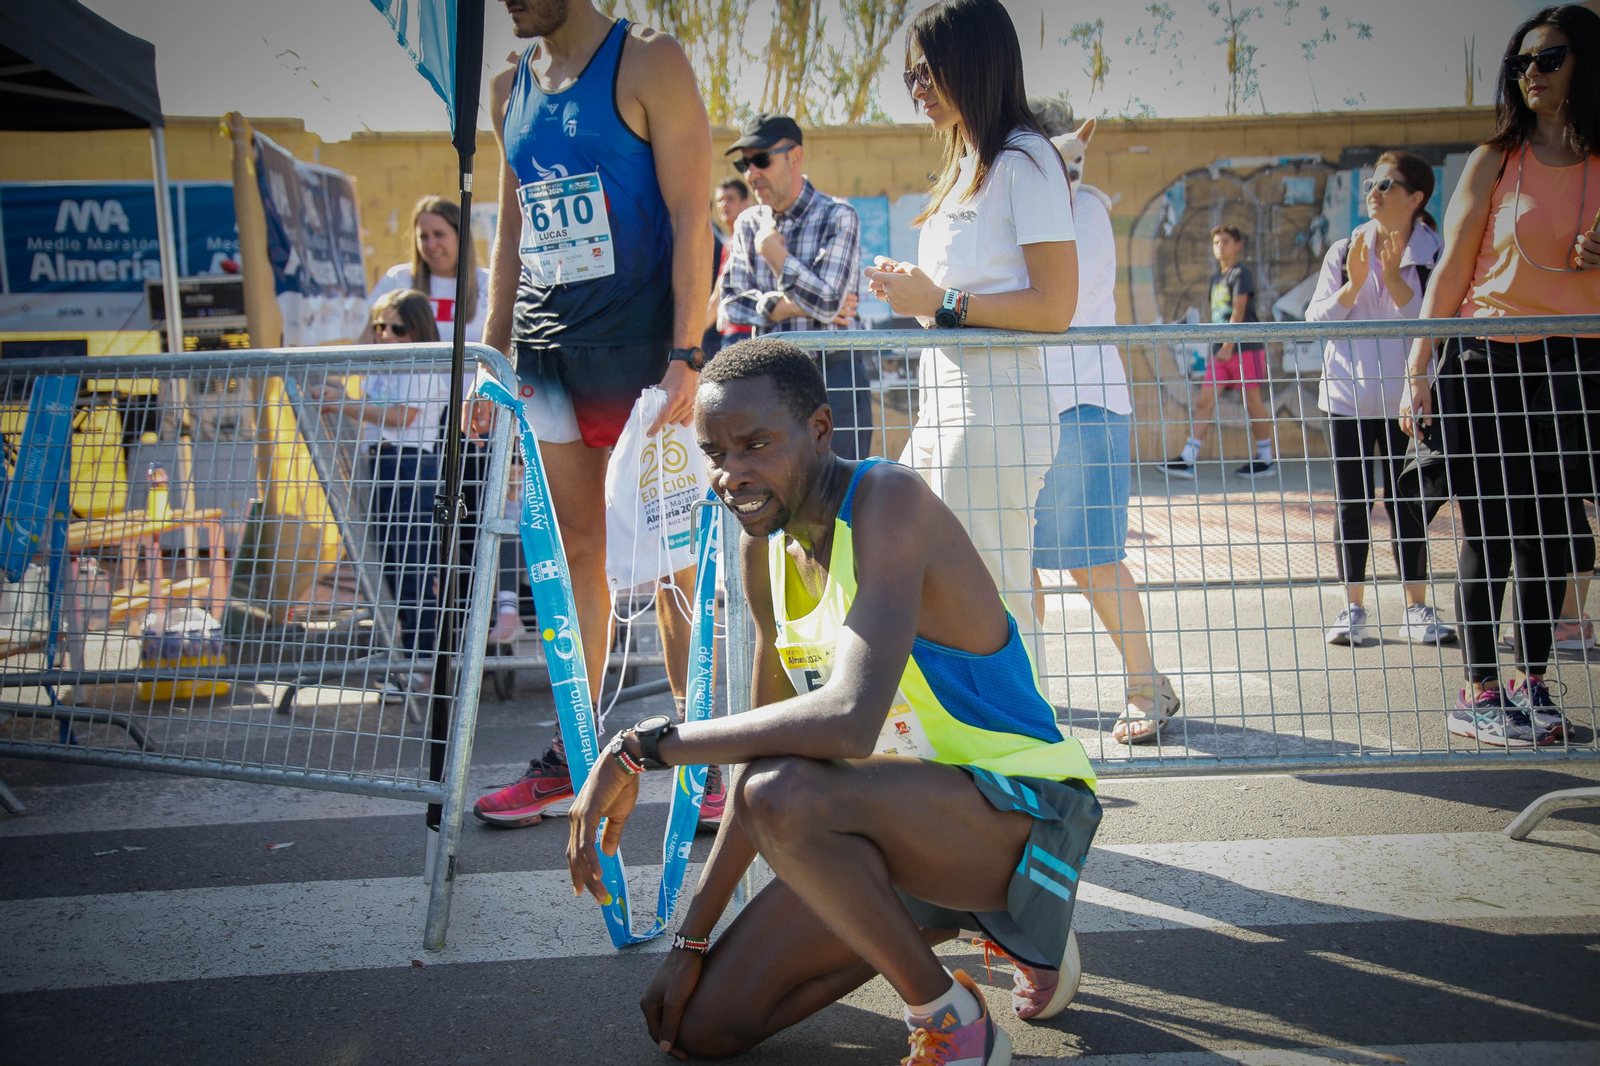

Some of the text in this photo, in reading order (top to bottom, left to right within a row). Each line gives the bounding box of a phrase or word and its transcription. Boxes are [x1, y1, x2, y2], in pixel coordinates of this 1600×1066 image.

[548, 187, 564, 196] 2024
[531, 194, 594, 232] 610
[27, 235, 161, 251] Medio Maratón
[538, 229, 568, 241] LUCAS
[29, 251, 162, 282] Almería
[641, 472, 698, 503] EDCIÓN
[695, 646, 710, 718] de Almería
[570, 690, 594, 777] untamiento
